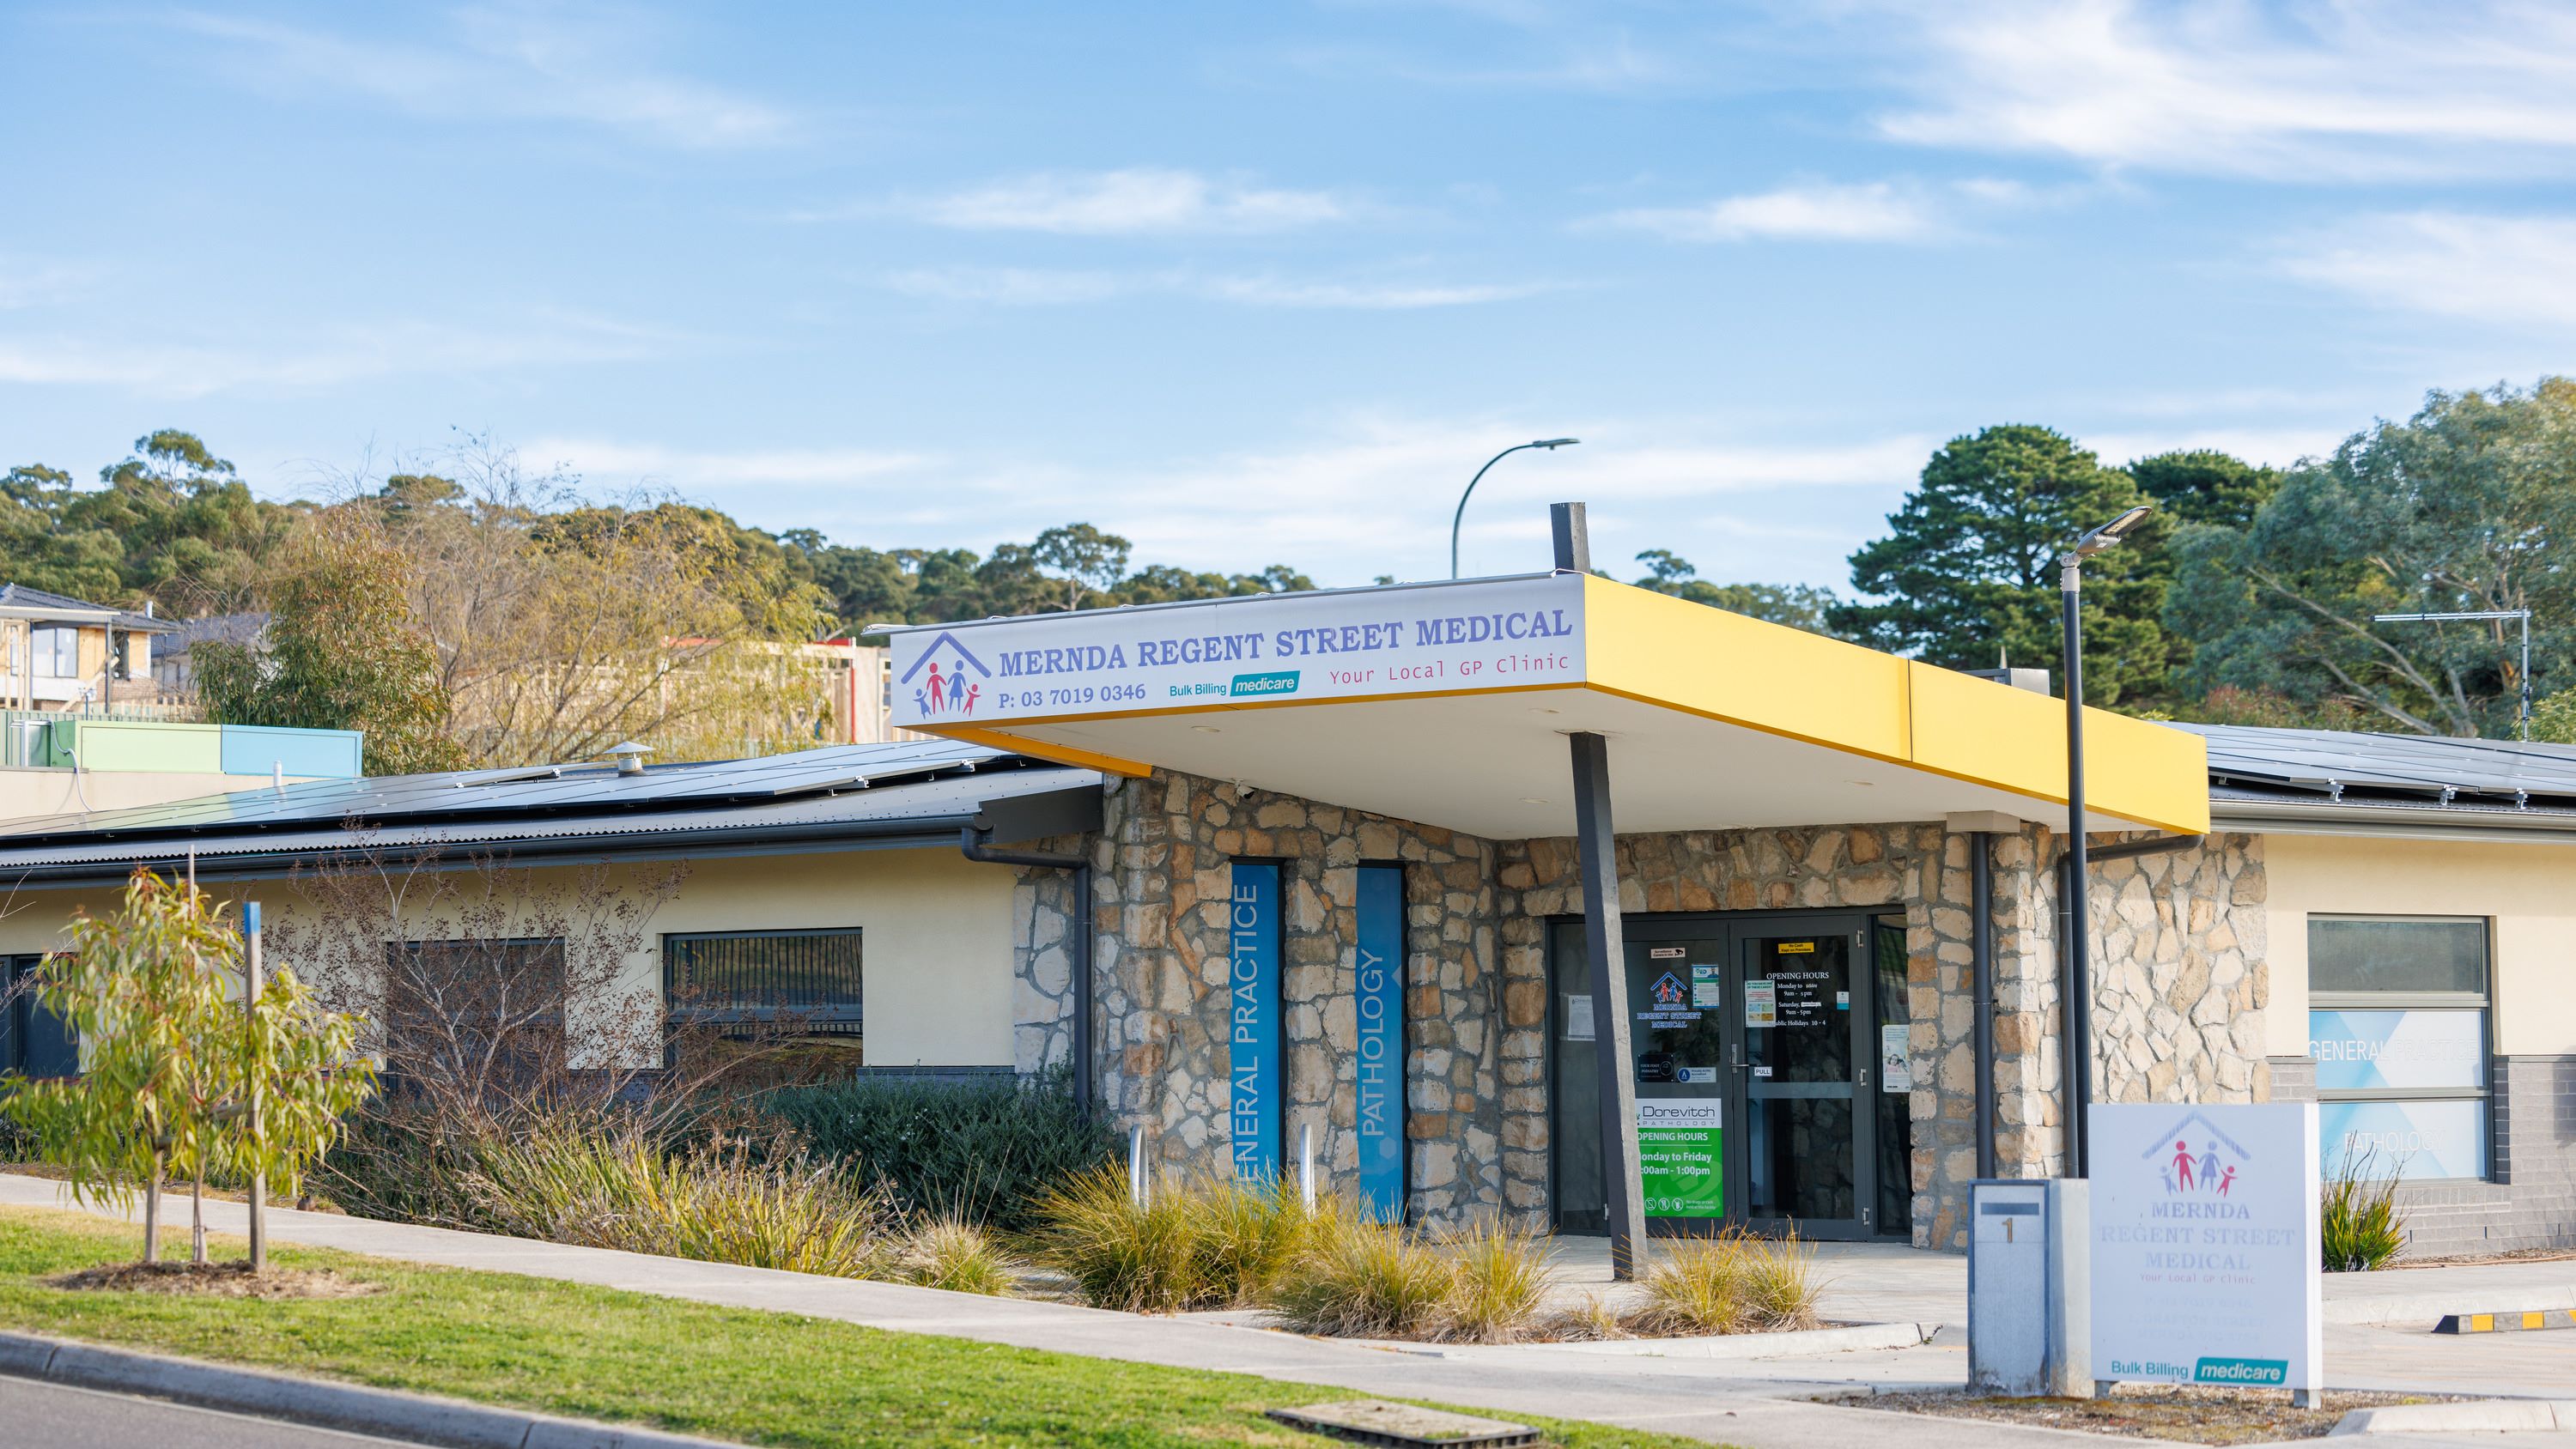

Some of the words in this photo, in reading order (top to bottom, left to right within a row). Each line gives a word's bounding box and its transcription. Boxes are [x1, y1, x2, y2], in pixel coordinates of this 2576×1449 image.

[999, 644, 1127, 677] MERNDA
[1138, 633, 1264, 667] REGENT
[1276, 621, 1403, 658] STREET
[1416, 609, 1572, 646] MEDICAL
[1329, 669, 1374, 685] Your
[1389, 661, 1443, 680] Local
[1460, 661, 1482, 676] GP
[1497, 653, 1568, 673] Clinic
[1170, 685, 1193, 696] Bulk
[1195, 682, 1226, 695] Billing
[1236, 677, 1295, 693] medicare
[999, 694, 1014, 708] P:
[1021, 691, 1042, 706] 03
[1049, 688, 1094, 705] 7019
[1101, 683, 1146, 701] 0346
[1235, 884, 1258, 1043] PRACTICE
[1670, 1011, 1702, 1020] STREET
[1361, 947, 1384, 1137] PATHOLOGY
[2307, 1040, 2388, 1061] GENERAL
[1235, 1056, 1258, 1183] ENERAL
[1643, 1106, 1716, 1117] Dorevitch
[1637, 1132, 1675, 1141] OPENING
[1677, 1132, 1709, 1141] HOURS
[1640, 1152, 1669, 1163] onday
[1683, 1152, 1712, 1163] Friday
[1640, 1166, 1668, 1175] :00am
[1676, 1166, 1710, 1177] 1:00pm
[2151, 1202, 2251, 1219] MERNDA
[2002, 1217, 2013, 1244] 1
[2100, 1226, 2194, 1243] REGENT
[2202, 1228, 2296, 1246] STREET
[2145, 1252, 2251, 1270] MEDICAL
[2140, 1273, 2161, 1282] Your
[2168, 1273, 2197, 1283] Local
[2221, 1275, 2257, 1285] Clinic
[2111, 1361, 2142, 1375] Bulk
[2146, 1361, 2189, 1379] Billing
[2201, 1361, 2281, 1381] medicare
